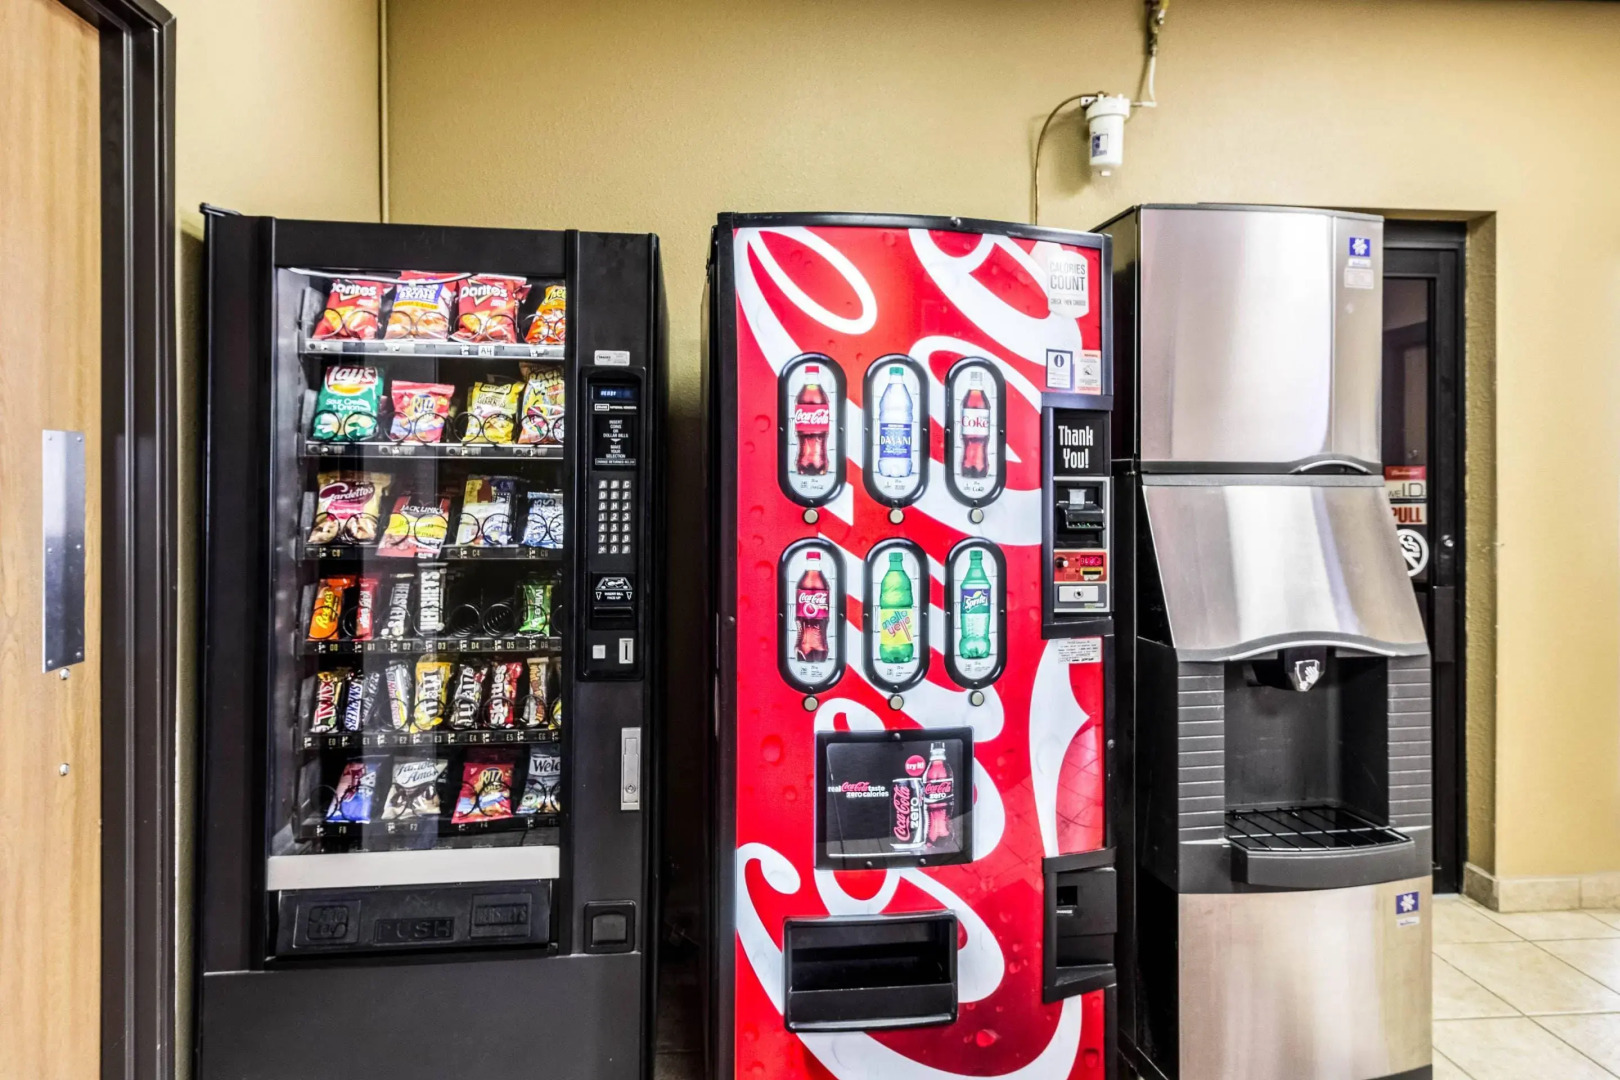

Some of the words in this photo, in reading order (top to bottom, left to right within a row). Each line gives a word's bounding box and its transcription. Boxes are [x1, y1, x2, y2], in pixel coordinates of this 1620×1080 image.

[1050, 261, 1086, 275] CALORIES
[460, 284, 508, 299] Doritos
[1050, 274, 1086, 292] COUNT
[480, 346, 492, 354] A4
[961, 416, 989, 428] Coke
[880, 435, 911, 445] DASANI
[1058, 425, 1094, 447] Thank
[1062, 448, 1090, 469] You!
[400, 504, 420, 513] JACK
[964, 595, 987, 610] Sprite
[881, 610, 908, 630] mello
[887, 616, 912, 642] yello
[314, 680, 336, 726] TWIX
[489, 664, 507, 725] Skittles
[344, 683, 362, 731] SNICKERS
[482, 770, 503, 783] RITZ
[910, 797, 919, 829] zero
[376, 919, 451, 941] PUSH
